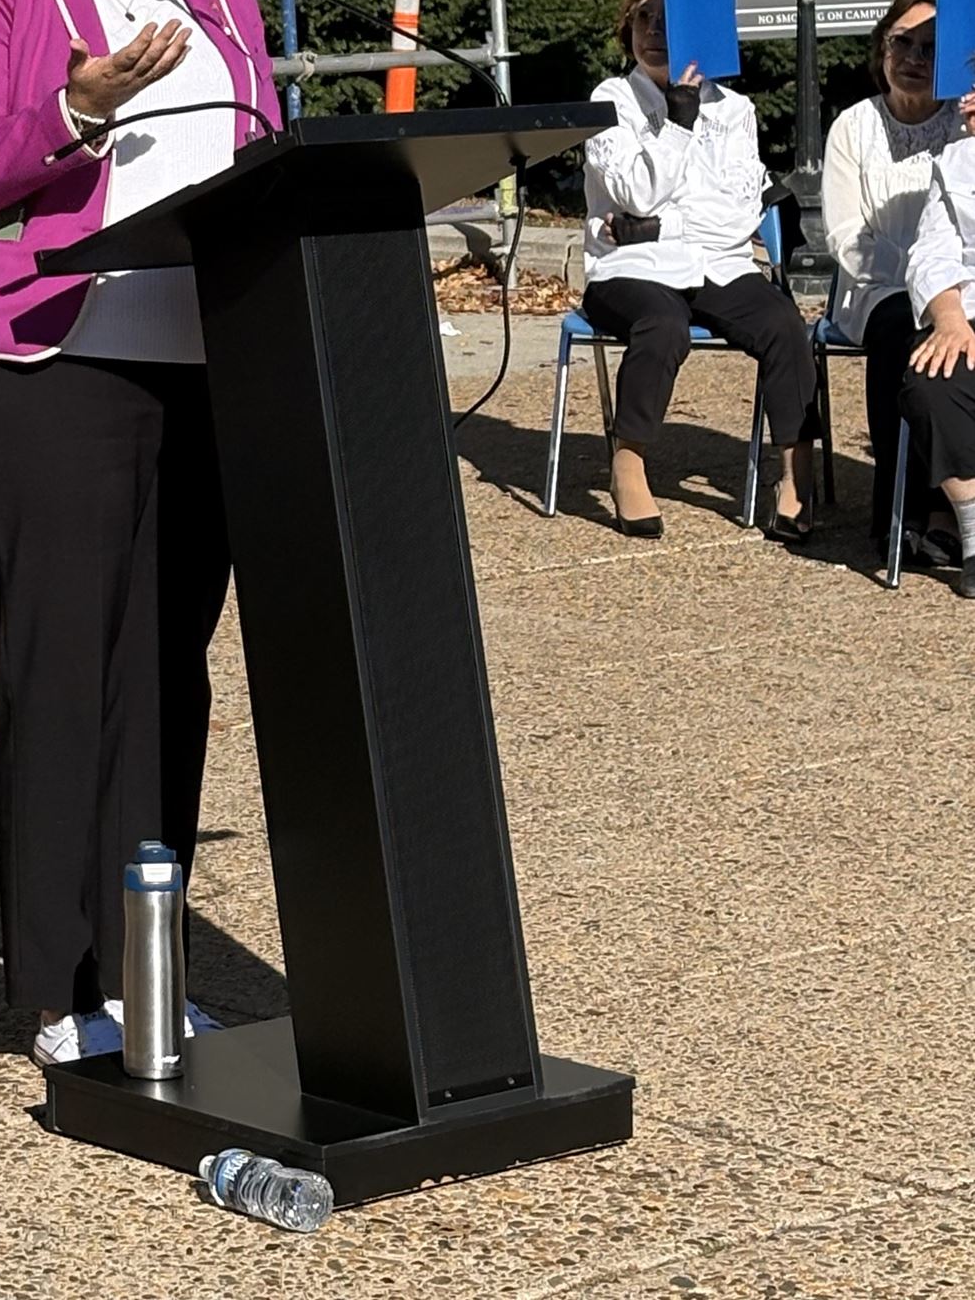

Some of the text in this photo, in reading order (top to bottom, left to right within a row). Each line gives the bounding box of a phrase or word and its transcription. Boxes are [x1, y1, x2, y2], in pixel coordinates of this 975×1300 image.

[758, 8, 889, 24] NO SMOG ON CAMPU
